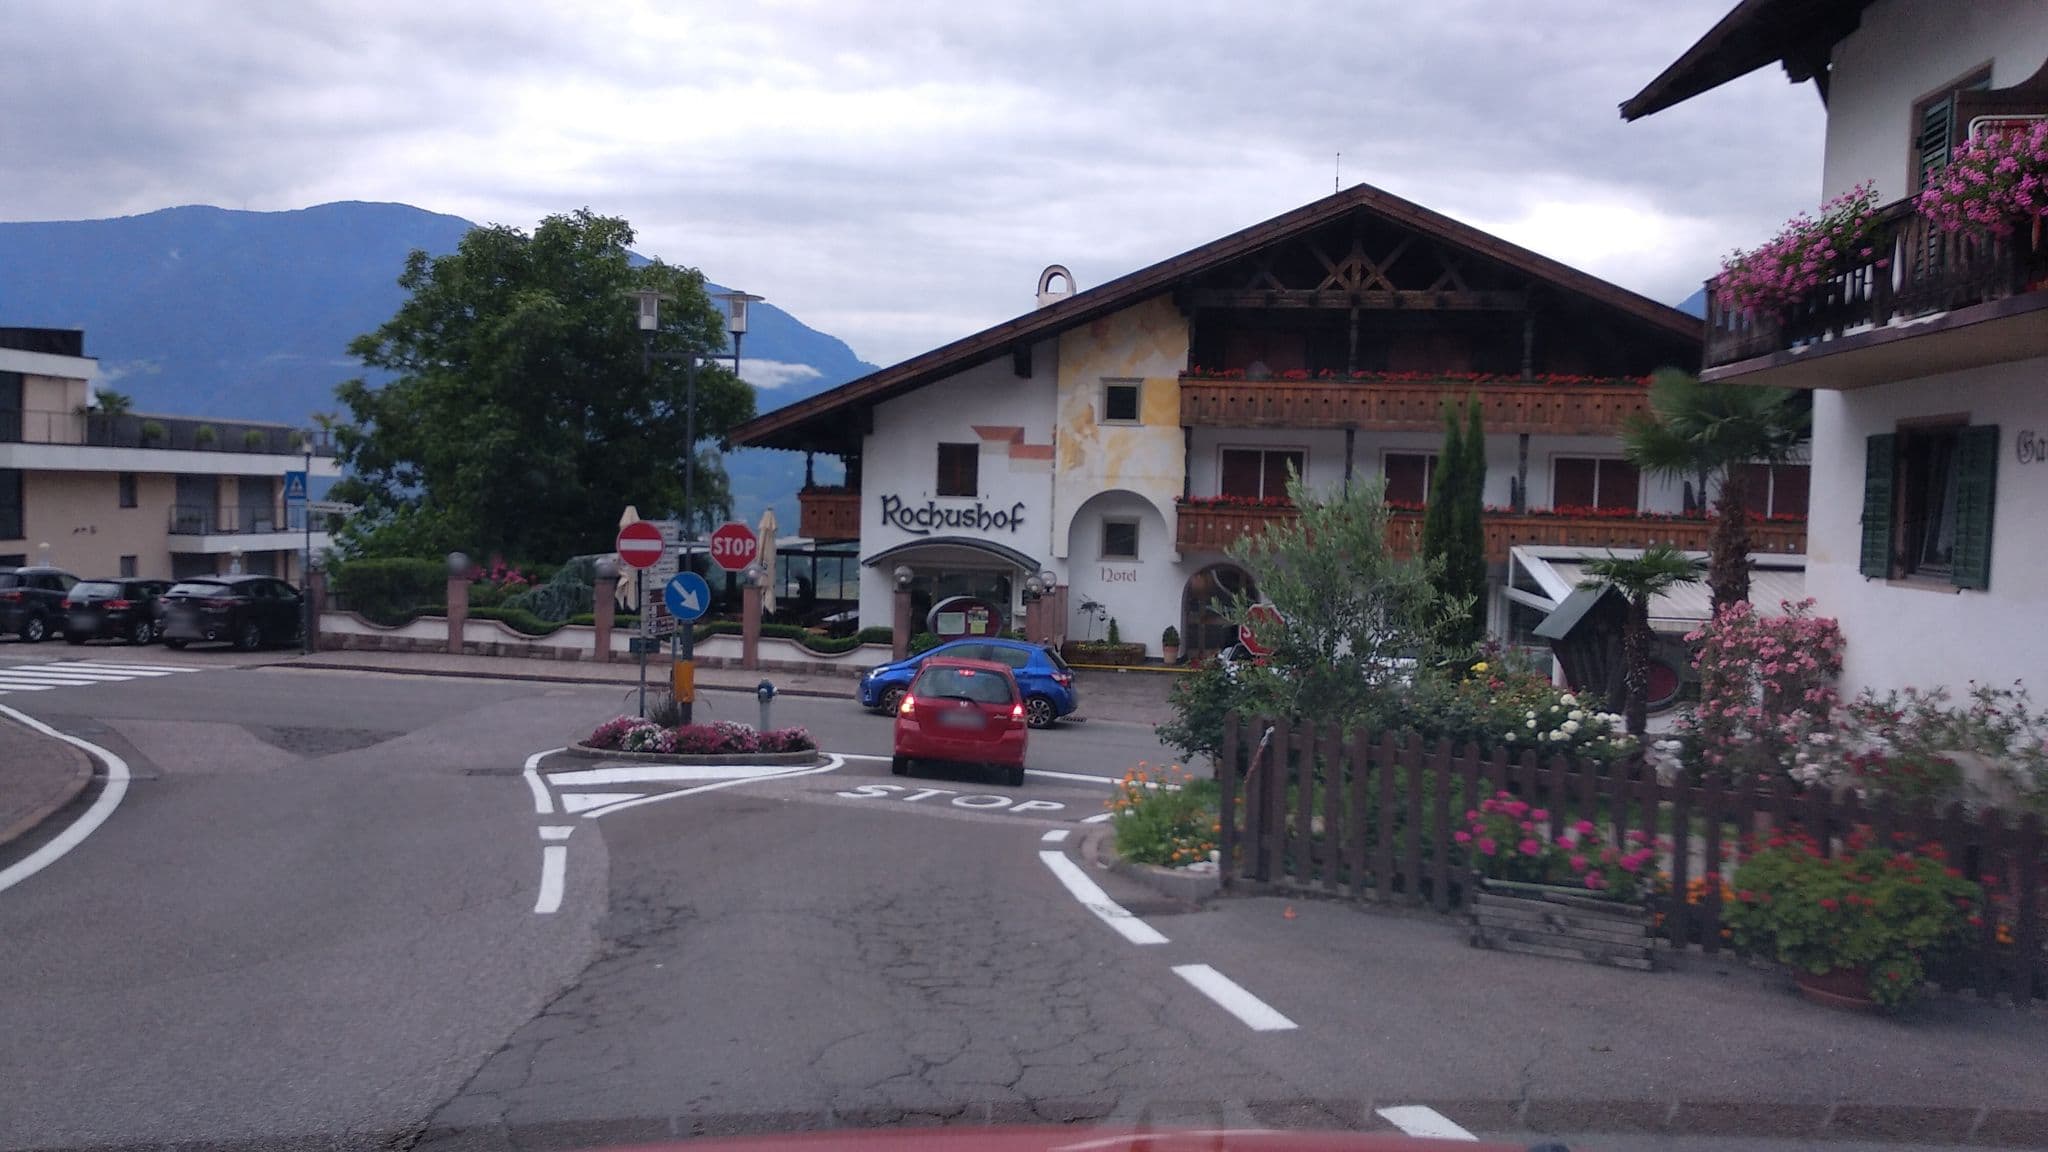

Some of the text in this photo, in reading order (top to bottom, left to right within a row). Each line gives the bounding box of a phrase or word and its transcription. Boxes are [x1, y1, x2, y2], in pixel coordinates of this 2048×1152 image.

[881, 494, 1025, 535] Rochushof
[713, 537, 756, 556] STOP
[1101, 566, 1137, 583] Hotel
[836, 784, 1066, 812] STOP
